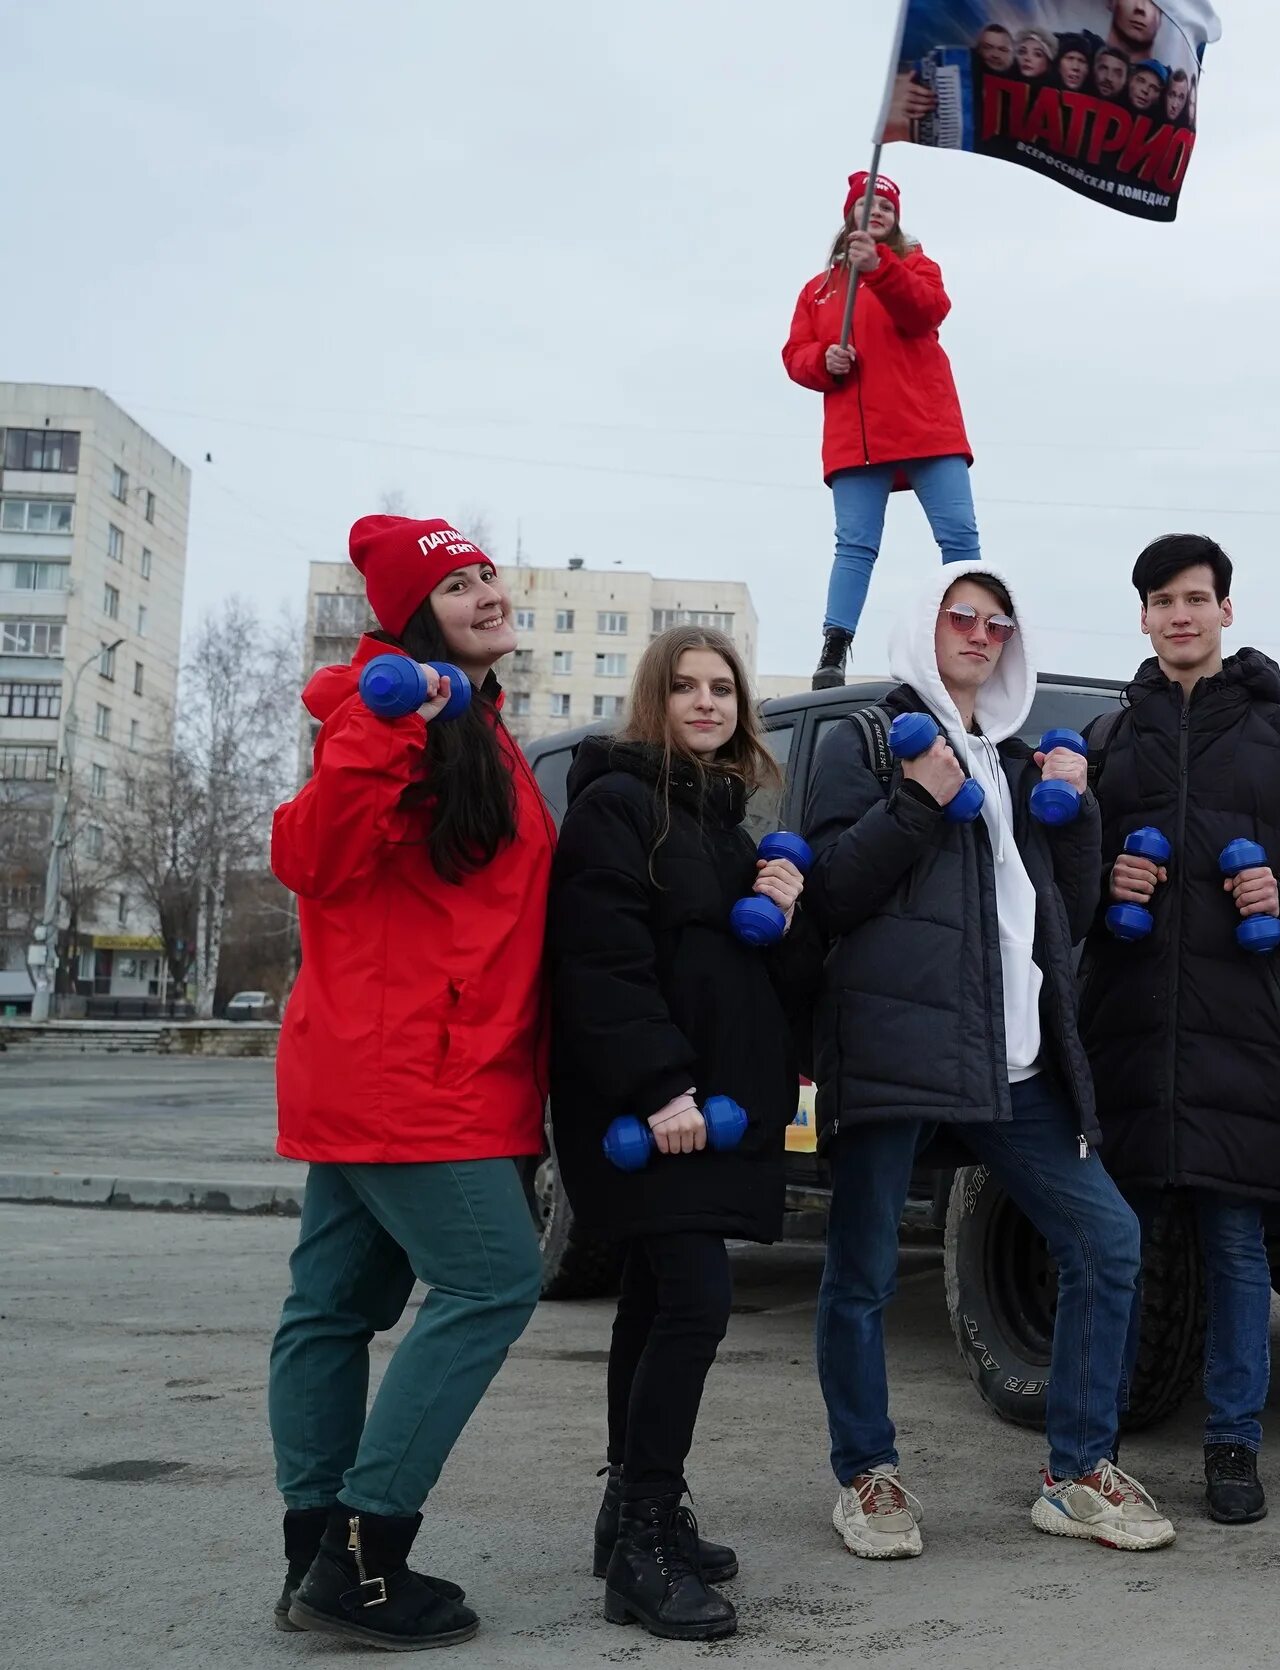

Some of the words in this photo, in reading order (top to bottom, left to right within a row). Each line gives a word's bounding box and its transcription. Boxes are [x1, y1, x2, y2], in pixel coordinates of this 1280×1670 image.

[1016, 141, 1115, 194] ВСЕРОССИЙСКАЯ
[1117, 183, 1171, 207] КОМЕДИЯ
[446, 543, 477, 555] ТНТ
